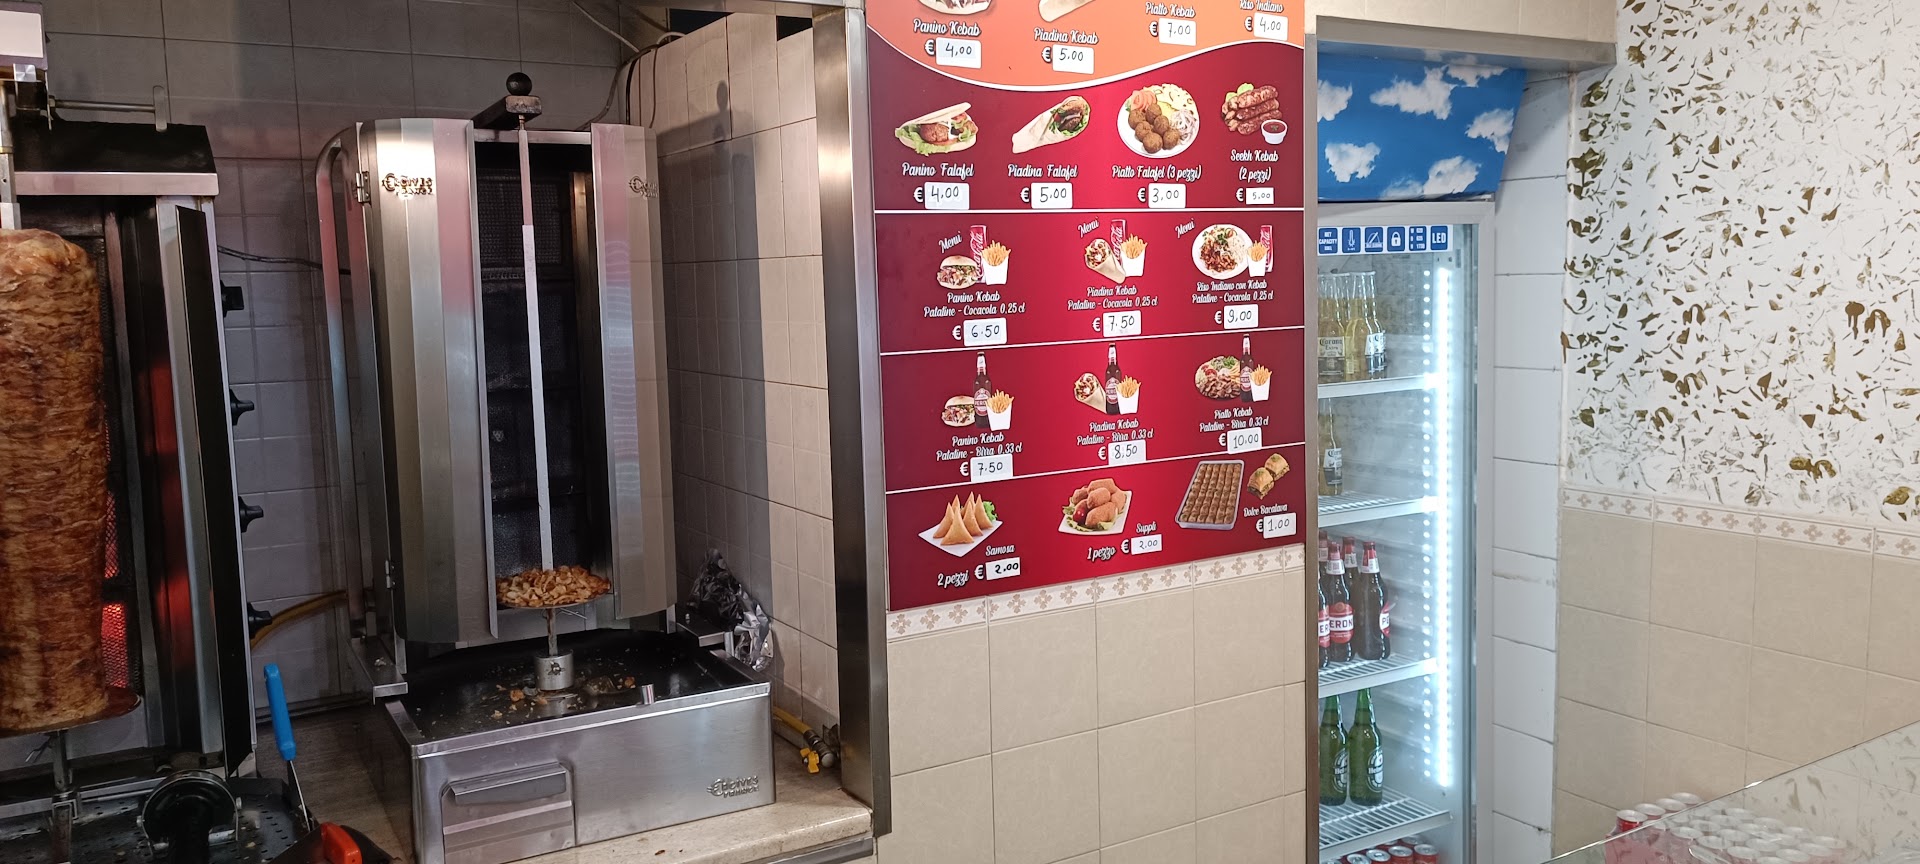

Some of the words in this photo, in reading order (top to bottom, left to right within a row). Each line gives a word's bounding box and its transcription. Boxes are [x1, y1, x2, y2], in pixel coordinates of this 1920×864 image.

[1146, 2, 1168, 16] Piatto
[1169, 4, 1196, 18] Kebab
[1256, 0, 1284, 12] Indiano
[913, 18, 948, 34] Panino
[949, 21, 981, 36] Kebab
[1149, 21, 1158, 36] €
[1245, 17, 1252, 31] €
[1034, 27, 1069, 43] Piadina
[1070, 30, 1099, 44] Kebab
[925, 39, 935, 56] €
[1042, 46, 1052, 62] €
[1230, 149, 1252, 162] Seekh
[1253, 150, 1278, 162] Kebab
[902, 162, 936, 177] Panino
[940, 163, 974, 180] Falafel
[1008, 164, 1043, 178] Piadina
[1047, 164, 1078, 181] Falafel
[1112, 165, 1135, 178] Piatto
[1137, 165, 1165, 181] Falafel
[1167, 164, 1175, 179] (3
[1176, 165, 1202, 182] pezzi)
[1239, 167, 1247, 180] (2
[1248, 167, 1272, 182] pezzi)
[914, 187, 923, 202] €
[1020, 187, 1030, 202] €
[1138, 188, 1146, 202] €
[1236, 188, 1243, 202] €
[1432, 233, 1446, 243] LED
[1087, 286, 1114, 296] Piadina
[1115, 285, 1137, 295] Kebab
[1211, 281, 1235, 290] Indiano
[1248, 279, 1267, 289] Kebab
[947, 292, 973, 303] Panino
[976, 290, 1001, 302] Kebab
[1103, 298, 1132, 308] Cocacola
[1224, 292, 1251, 302] Cocacola
[964, 304, 997, 315] Cocacola
[1092, 318, 1100, 331] €
[1215, 311, 1222, 324] €
[952, 325, 961, 340] €
[1214, 410, 1231, 419] Piatto
[1233, 407, 1252, 417] Kebab
[1089, 421, 1115, 432] Piadina
[1117, 418, 1139, 429] Kebab
[1231, 419, 1246, 429] Birra
[952, 436, 978, 447] Panino
[980, 432, 1004, 444] Kebab
[1112, 432, 1129, 441] Birra
[1219, 433, 1226, 446] €
[976, 446, 994, 456] Birra
[1098, 446, 1106, 460] €
[960, 462, 969, 476] €
[1244, 507, 1259, 517] Dolce
[1256, 519, 1263, 532] €
[986, 545, 1015, 556] Samosa
[1121, 539, 1129, 553] €
[1087, 547, 1092, 559] 1
[1092, 547, 1116, 561] pezzo
[938, 574, 944, 586] 2
[944, 570, 969, 588] pezzi
[975, 565, 983, 579] €
